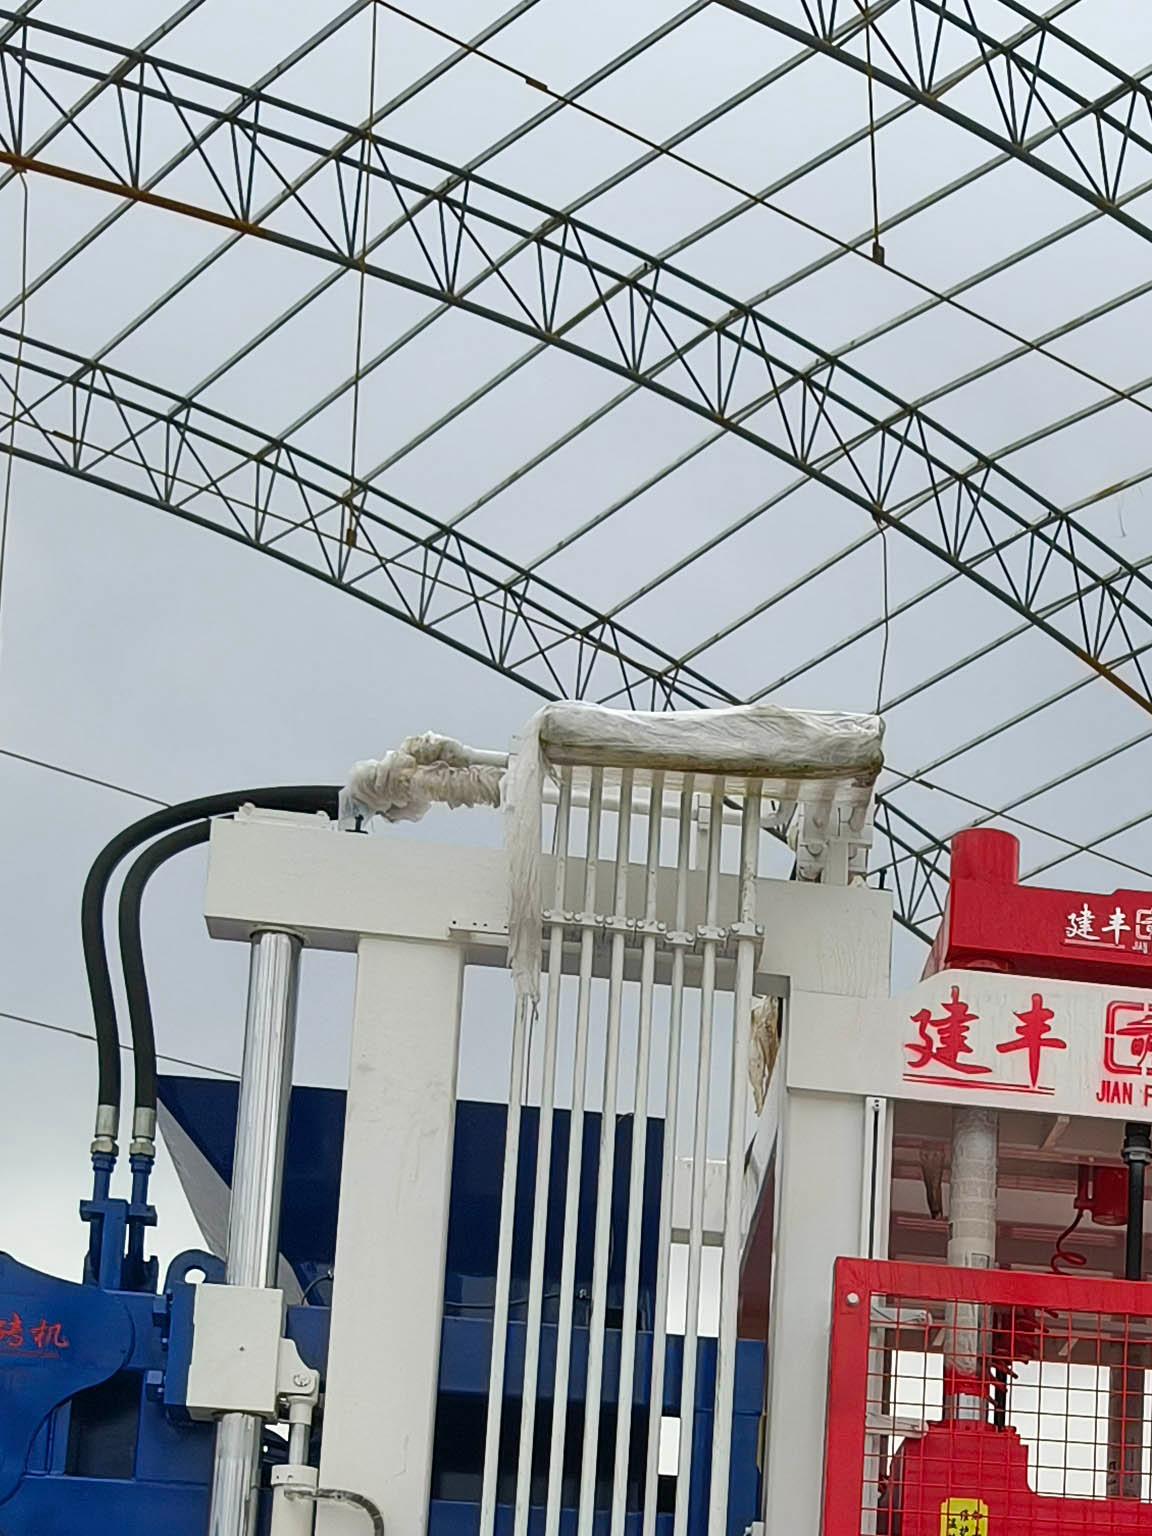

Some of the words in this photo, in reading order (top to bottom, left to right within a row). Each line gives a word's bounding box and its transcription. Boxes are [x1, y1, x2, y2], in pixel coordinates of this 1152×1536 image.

[1065, 903, 1131, 946] 建丰
[904, 985, 1067, 1088] 建丰
[1095, 1080, 1133, 1106] JIAN
